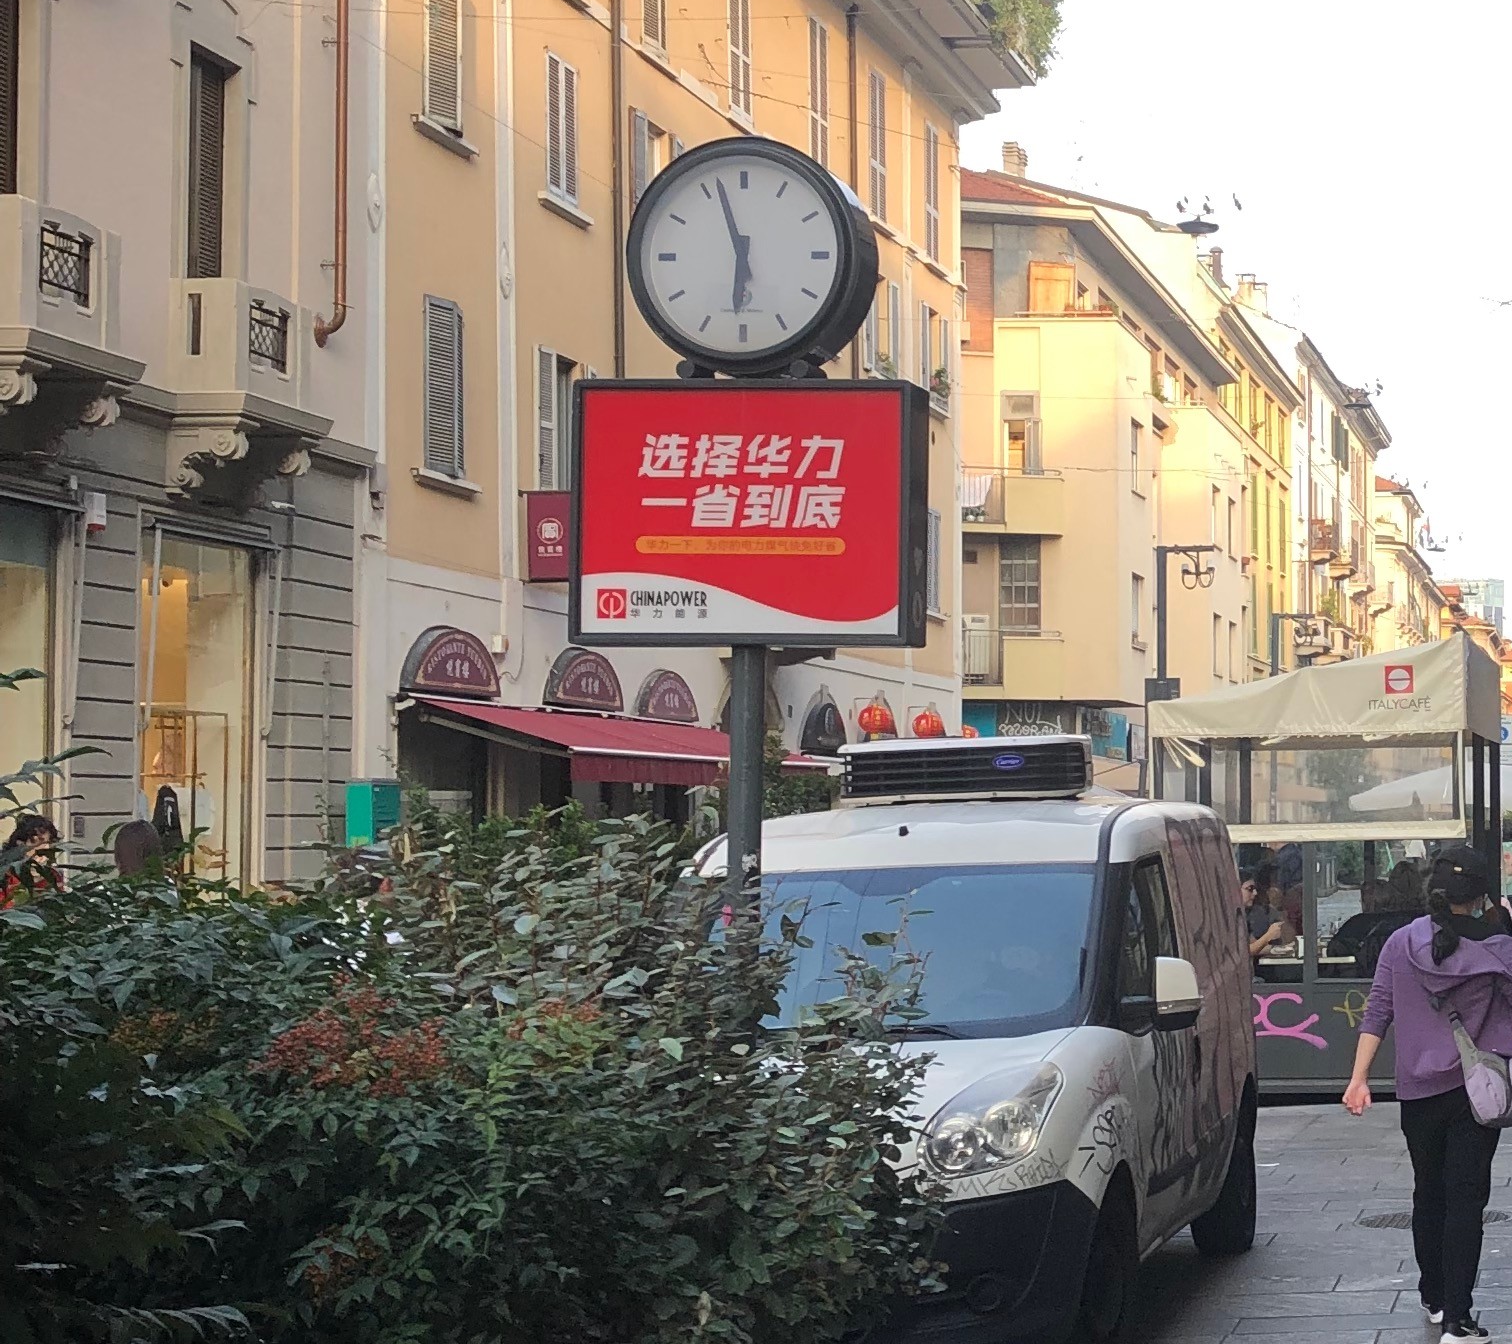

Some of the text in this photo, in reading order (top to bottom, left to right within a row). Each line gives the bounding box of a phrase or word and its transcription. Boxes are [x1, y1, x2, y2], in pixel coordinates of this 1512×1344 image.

[638, 433, 844, 479] 选择华力
[641, 484, 846, 529] 一省到底
[630, 590, 708, 606] CHINAPOWER
